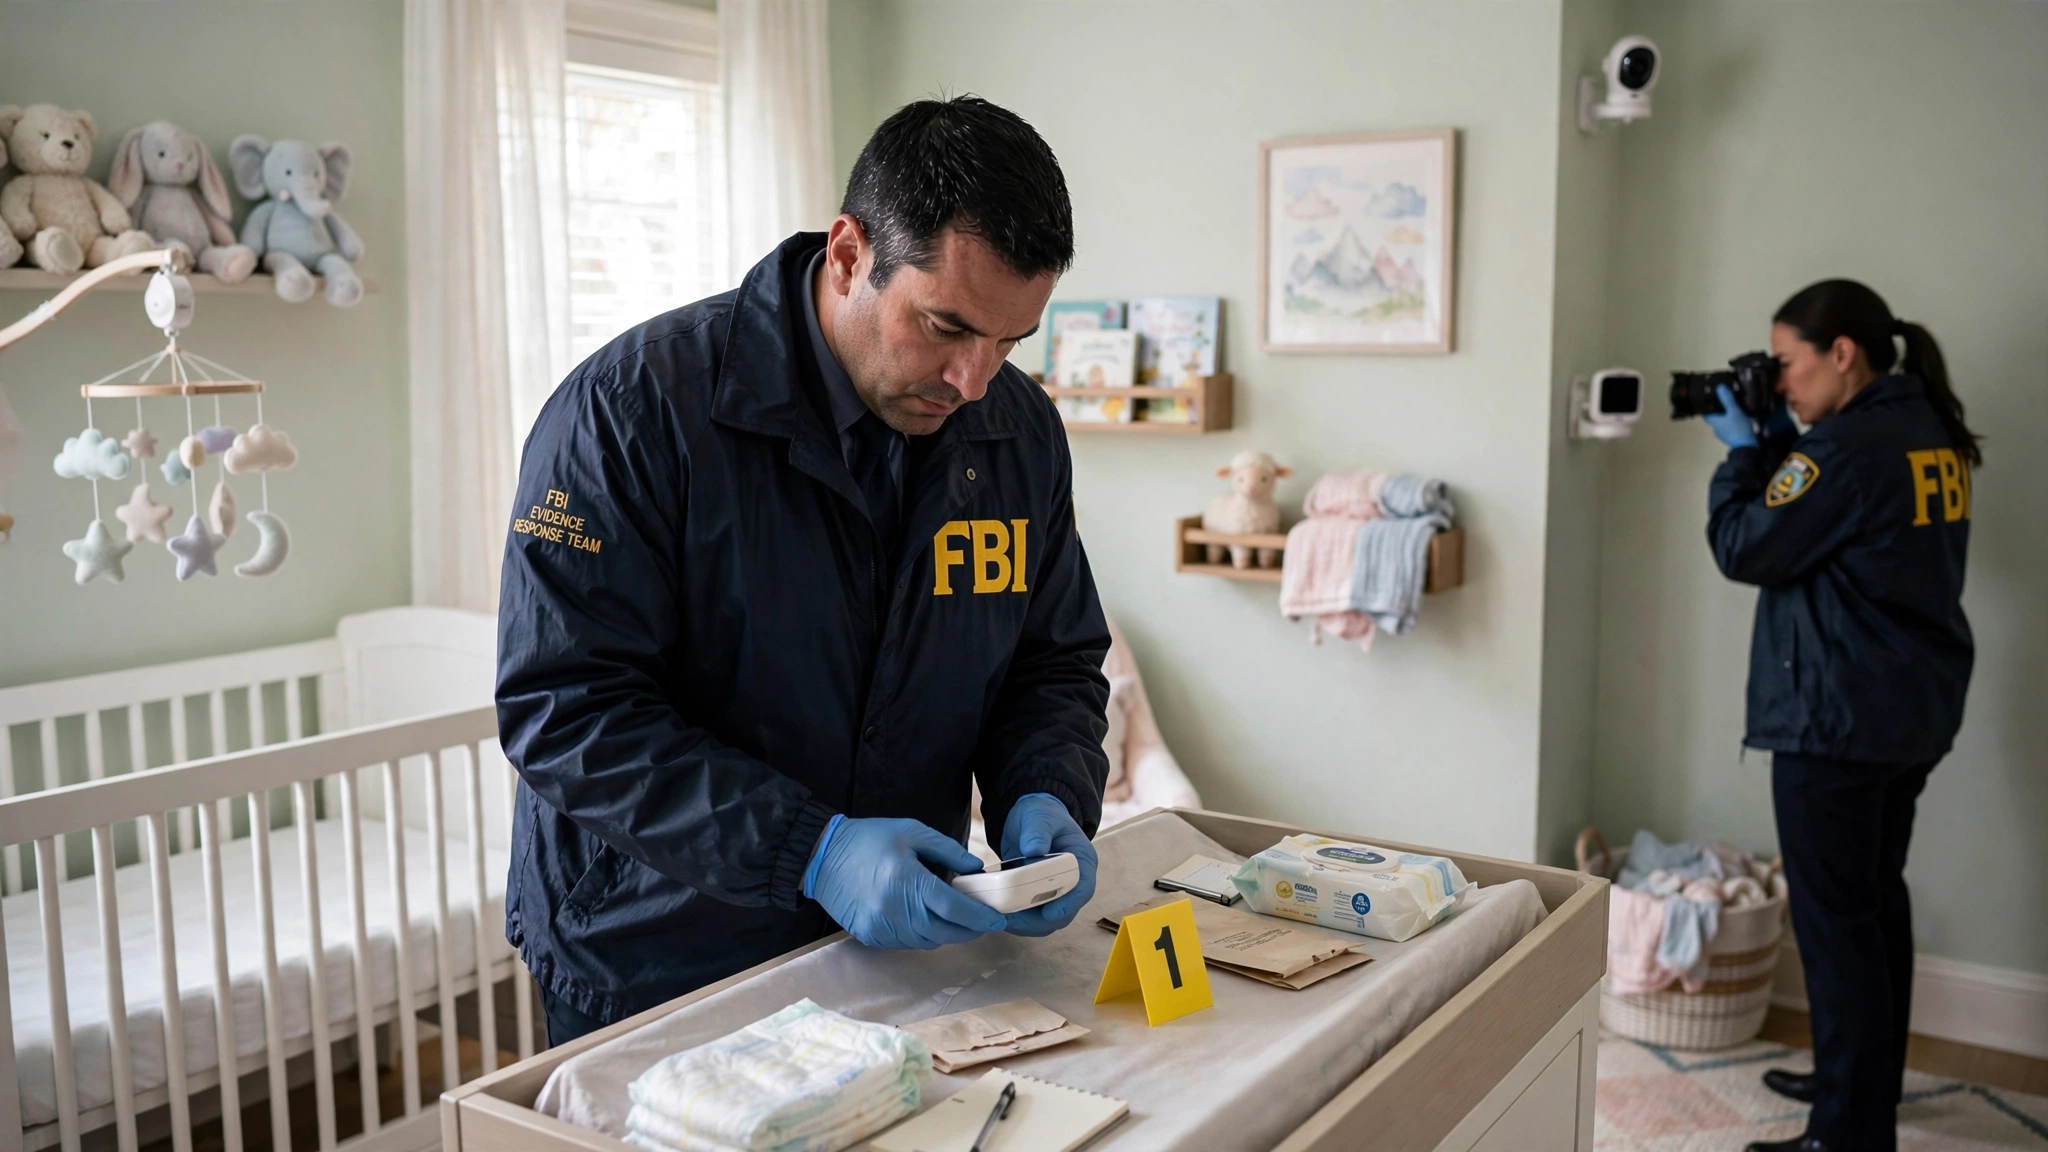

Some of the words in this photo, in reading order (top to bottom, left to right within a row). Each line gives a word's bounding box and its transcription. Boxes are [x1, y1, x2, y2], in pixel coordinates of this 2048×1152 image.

[545, 489, 570, 510] FBI
[513, 518, 565, 543] RESPONSE
[567, 532, 602, 554] TEAM
[530, 505, 586, 531] EVIDENCE
[933, 518, 1030, 596] FBI
[1153, 925, 1183, 991] 1
